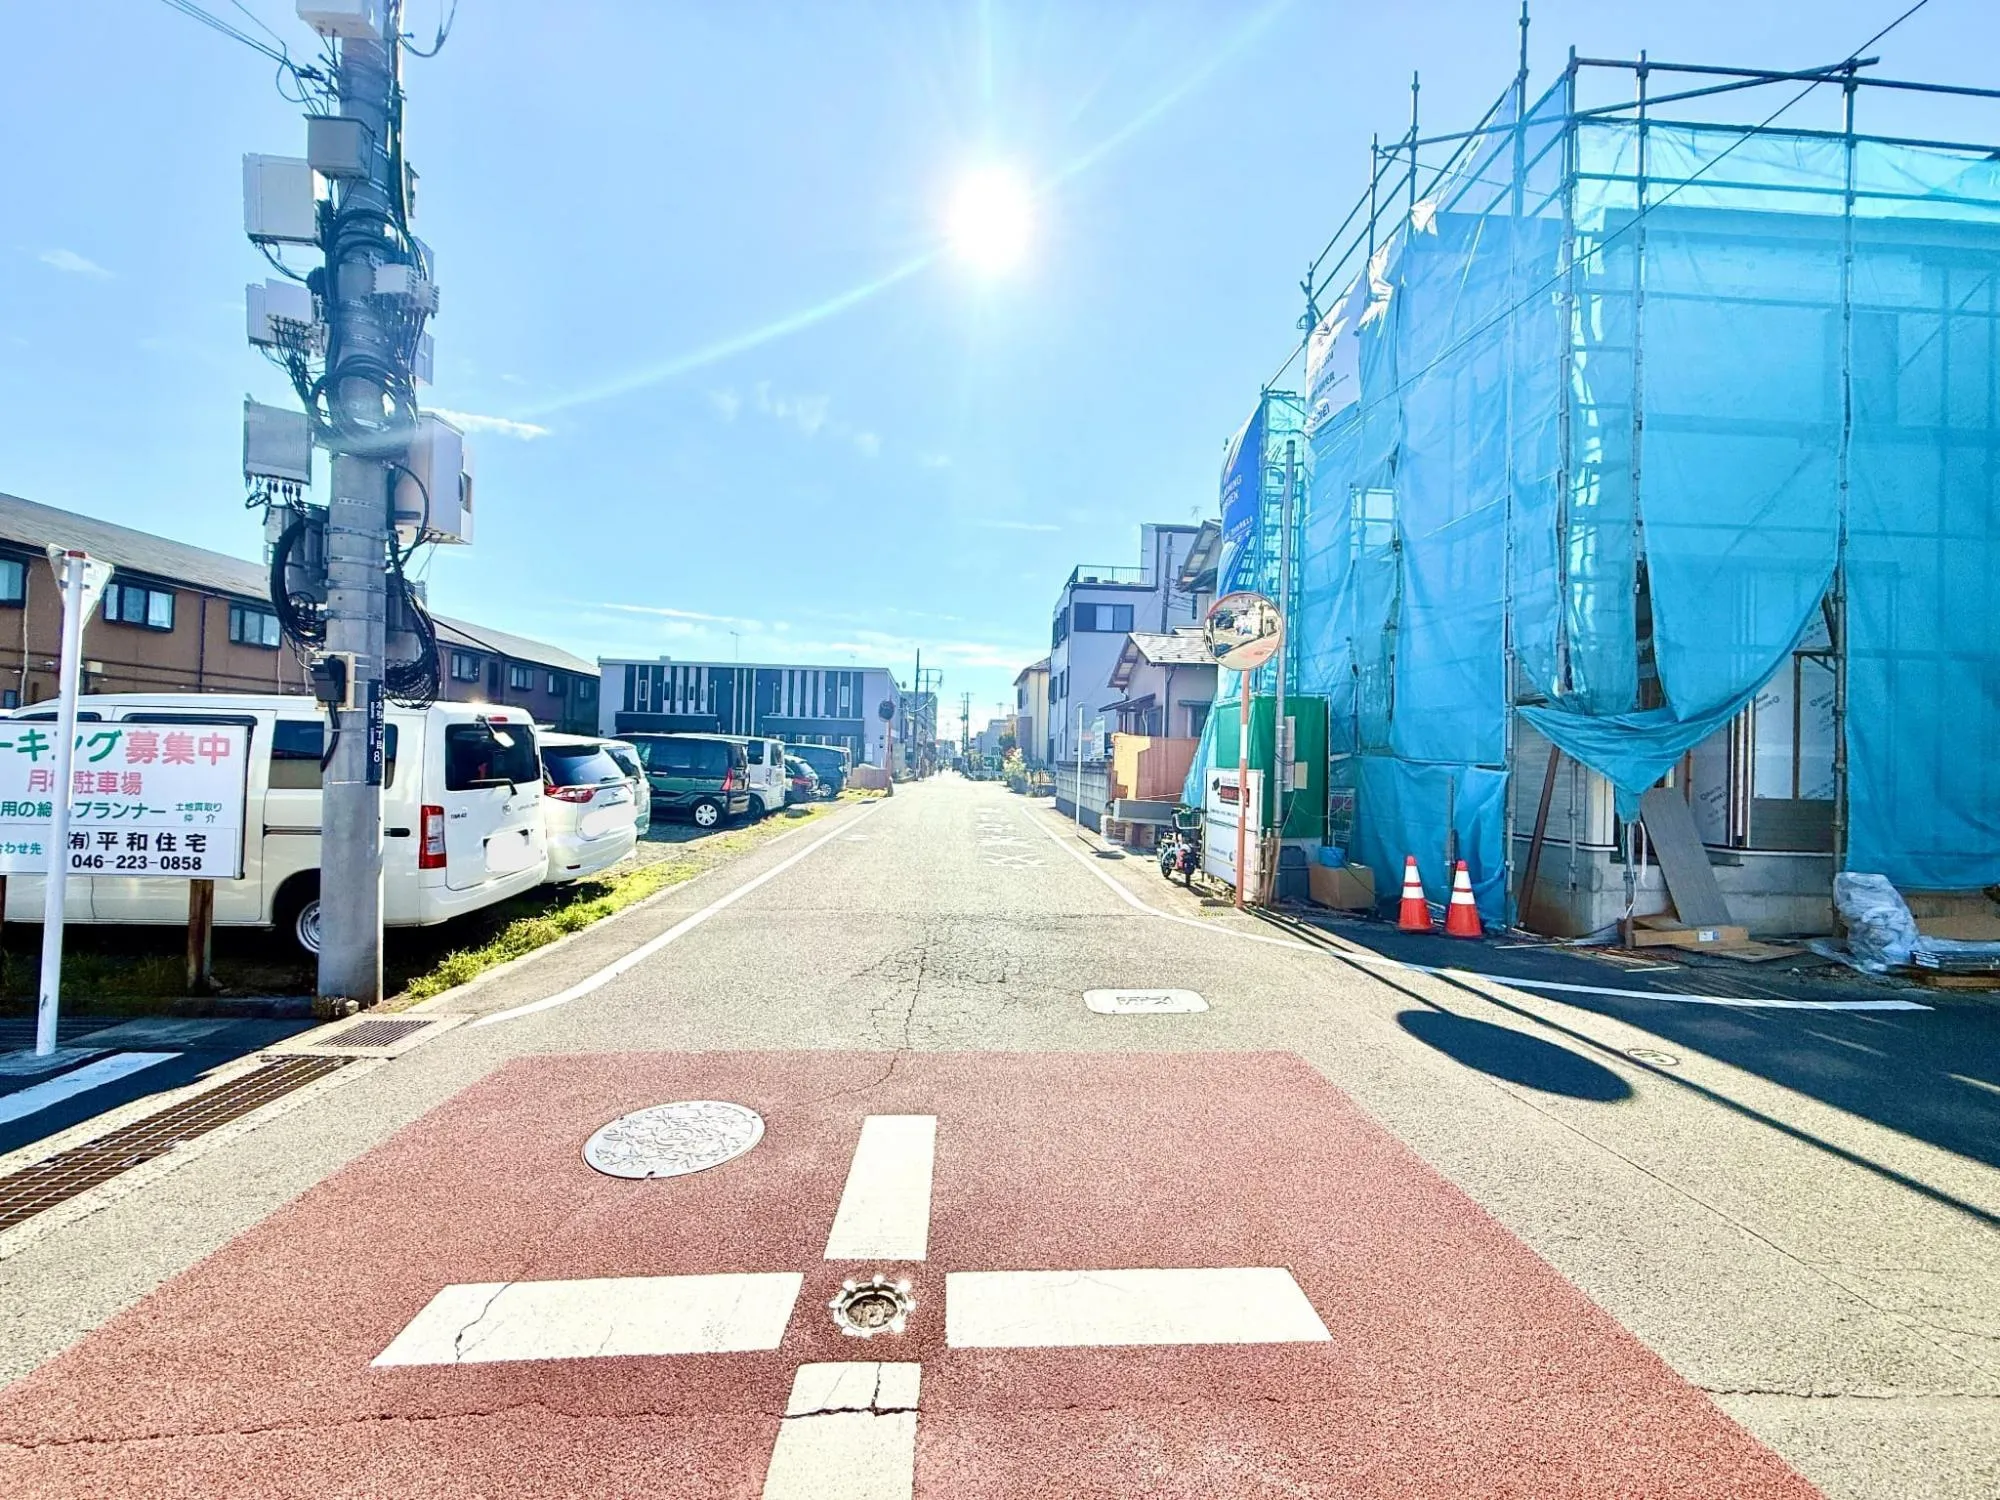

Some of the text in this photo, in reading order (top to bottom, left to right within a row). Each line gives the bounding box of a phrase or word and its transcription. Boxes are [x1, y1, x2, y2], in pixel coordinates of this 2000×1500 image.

[374, 751, 381, 762] 8
[1, 800, 166, 820] 用の総プランナー
[0, 842, 42, 855] わせ先
[71, 854, 202, 870] 046-223-0858
